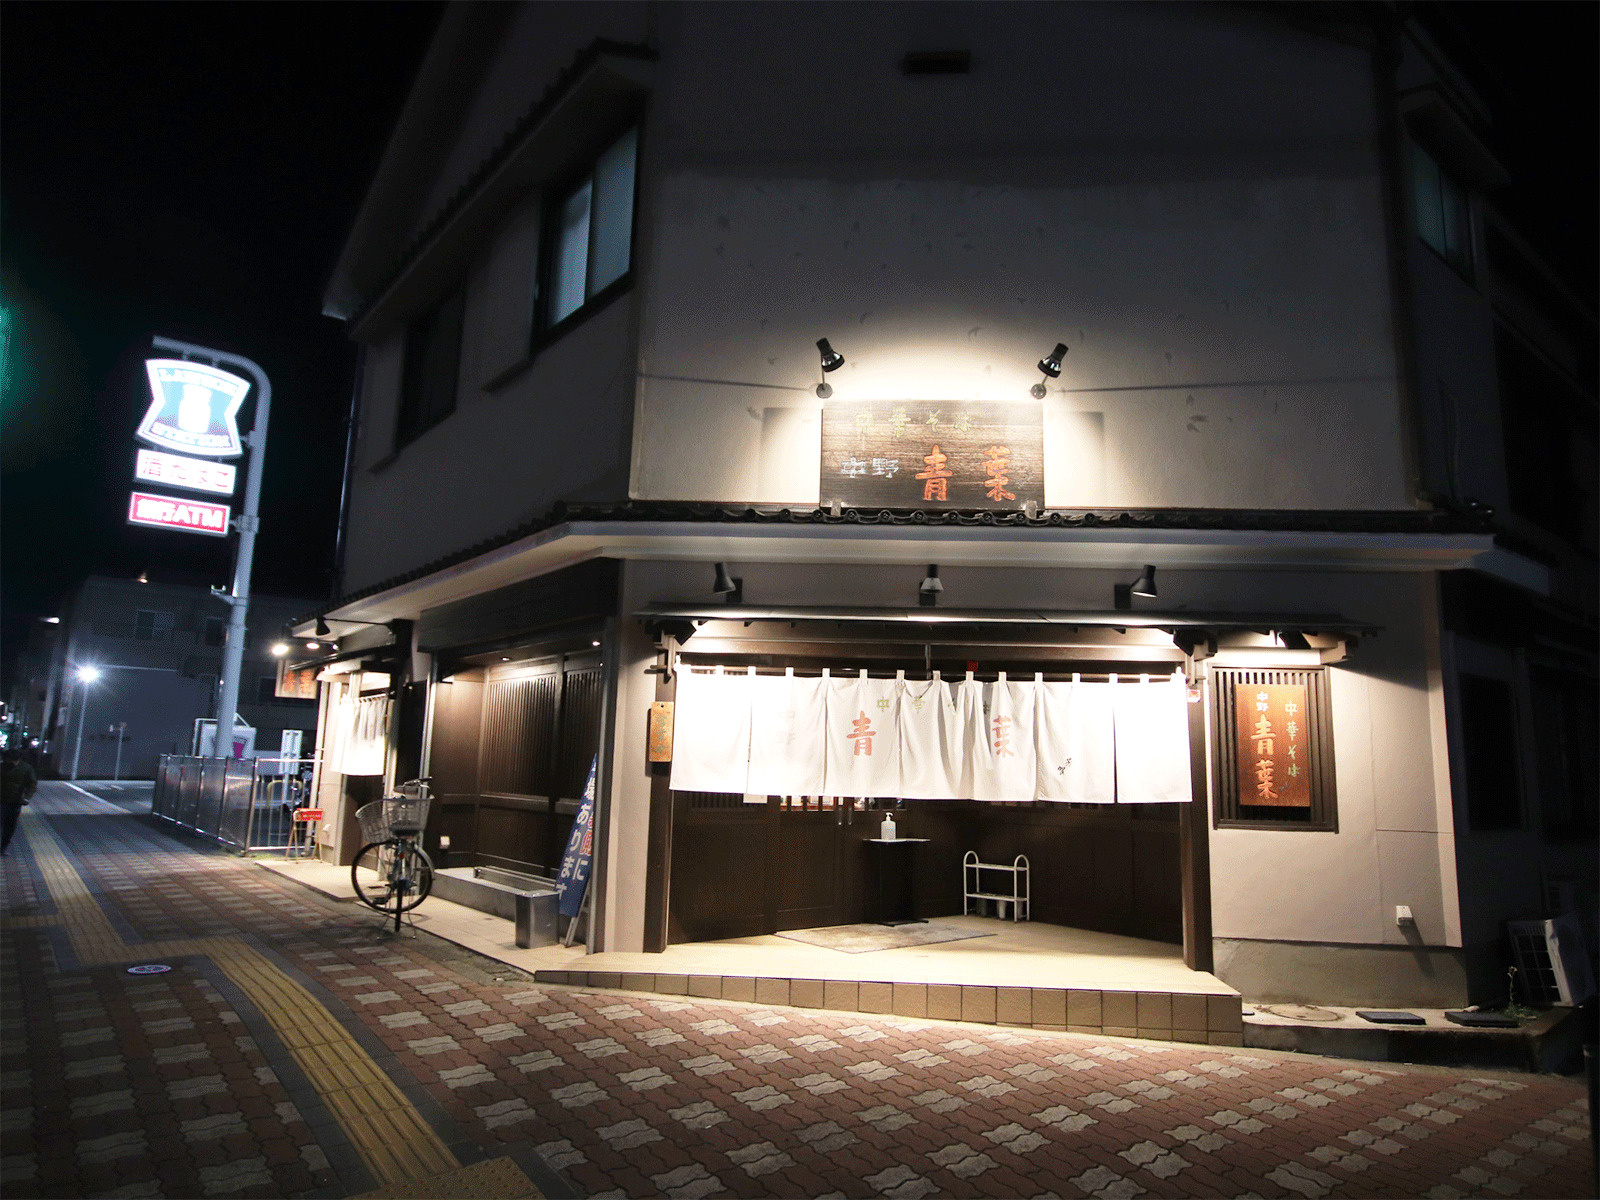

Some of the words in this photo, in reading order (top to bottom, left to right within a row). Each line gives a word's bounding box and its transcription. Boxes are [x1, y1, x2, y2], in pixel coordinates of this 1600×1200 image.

[840, 457, 898, 478] 中野
[915, 444, 1016, 501] 青葉
[1256, 691, 1269, 712] 中野
[1251, 713, 1278, 799] 青葉
